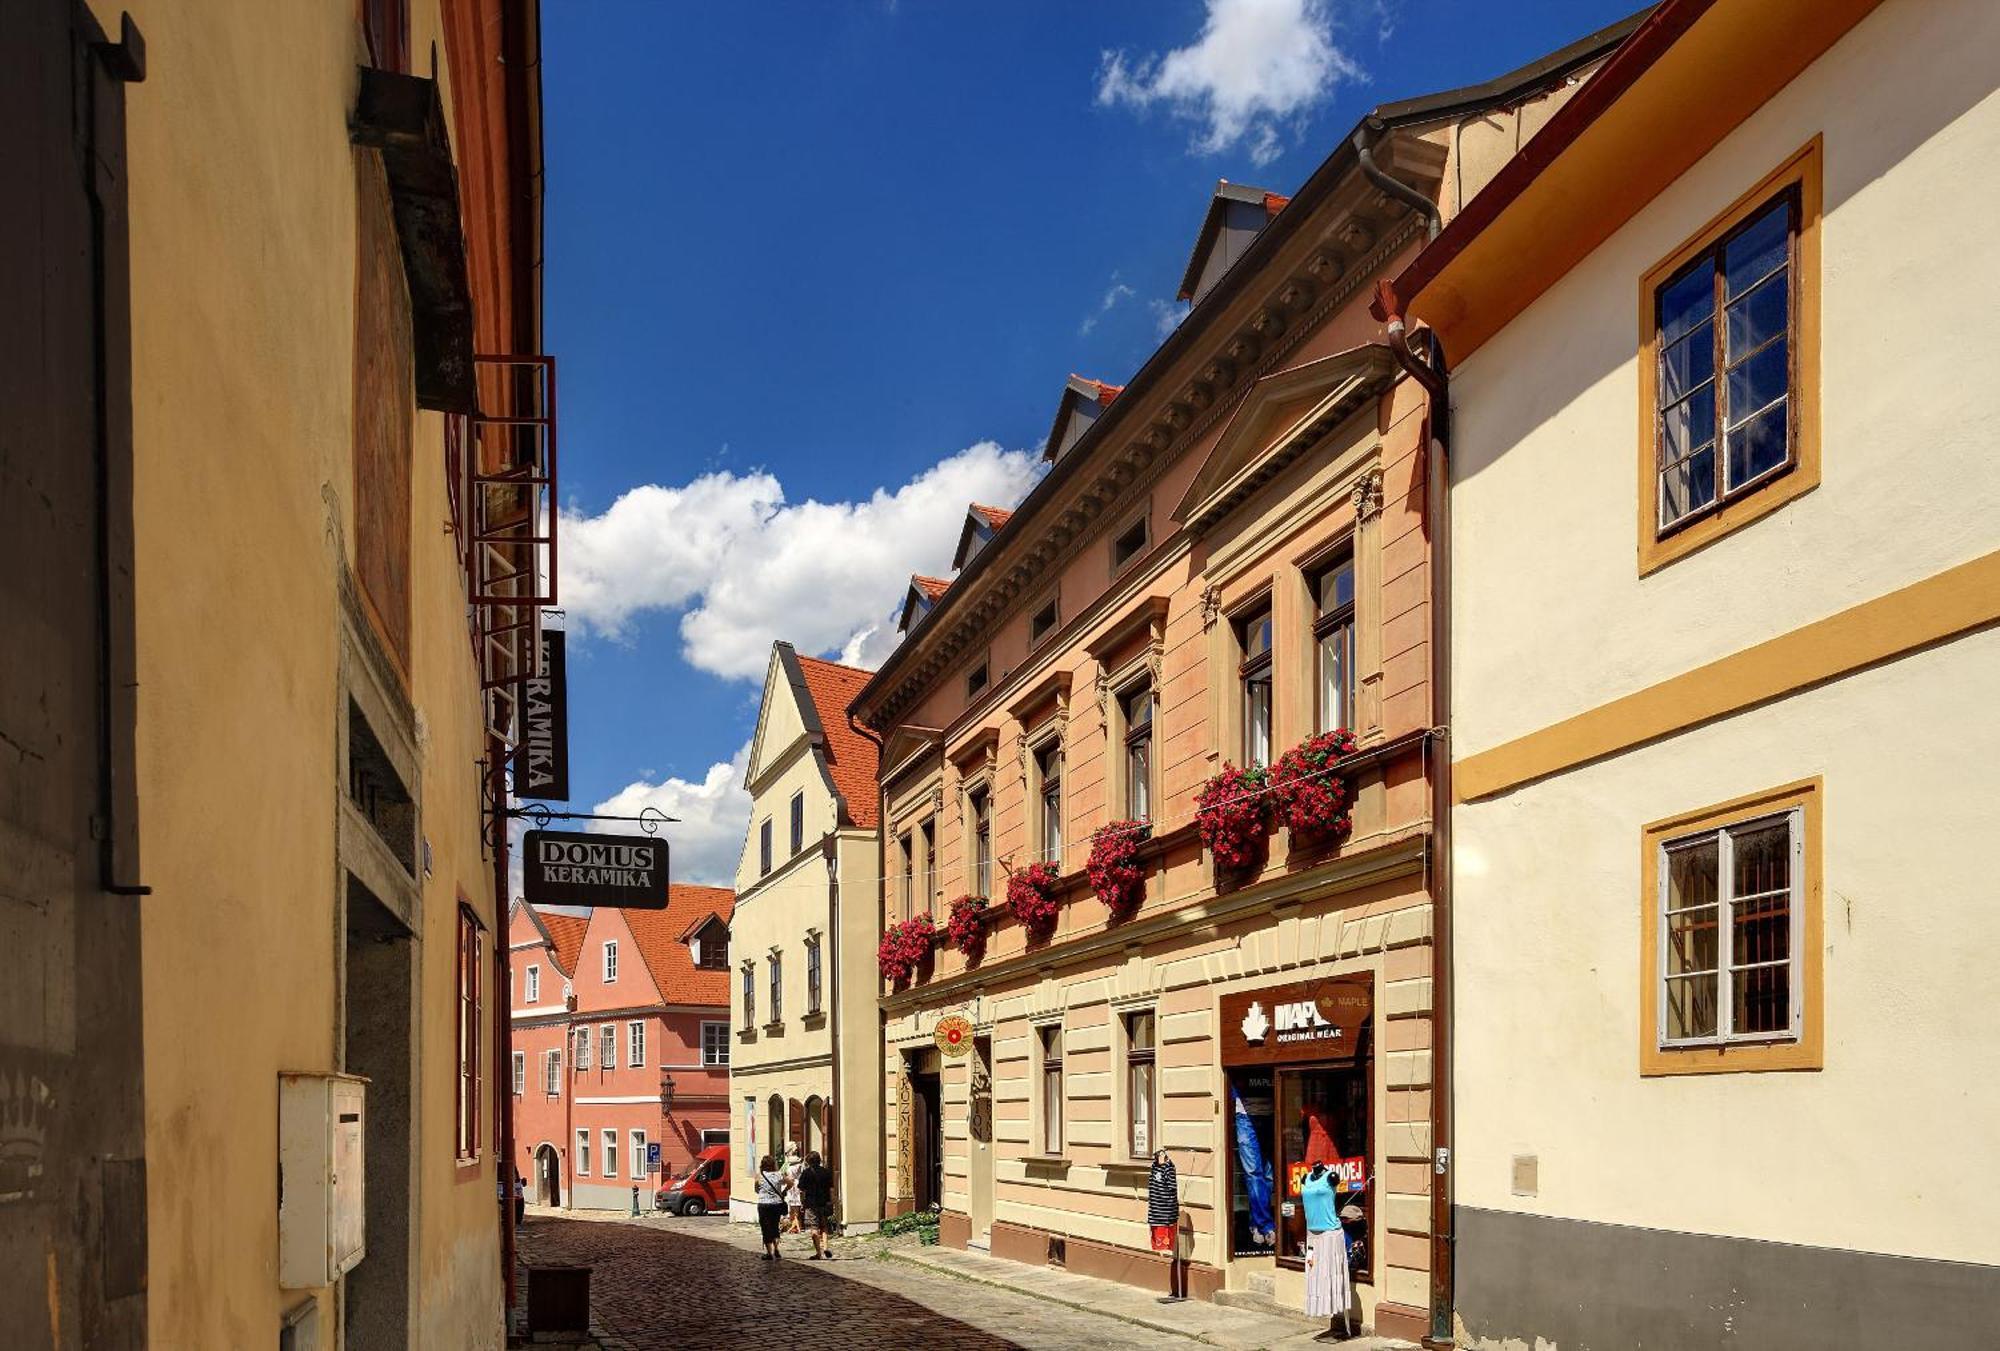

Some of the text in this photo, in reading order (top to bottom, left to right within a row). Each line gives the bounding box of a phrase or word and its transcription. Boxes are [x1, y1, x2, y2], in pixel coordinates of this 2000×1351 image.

[542, 842, 653, 868] DOMUS
[543, 865, 652, 888] KERAMIKA
[1338, 996, 1369, 1008] MAPLE
[1277, 1029, 1343, 1043] ORIGINAL WEAR
[650, 1145, 658, 1157] P
